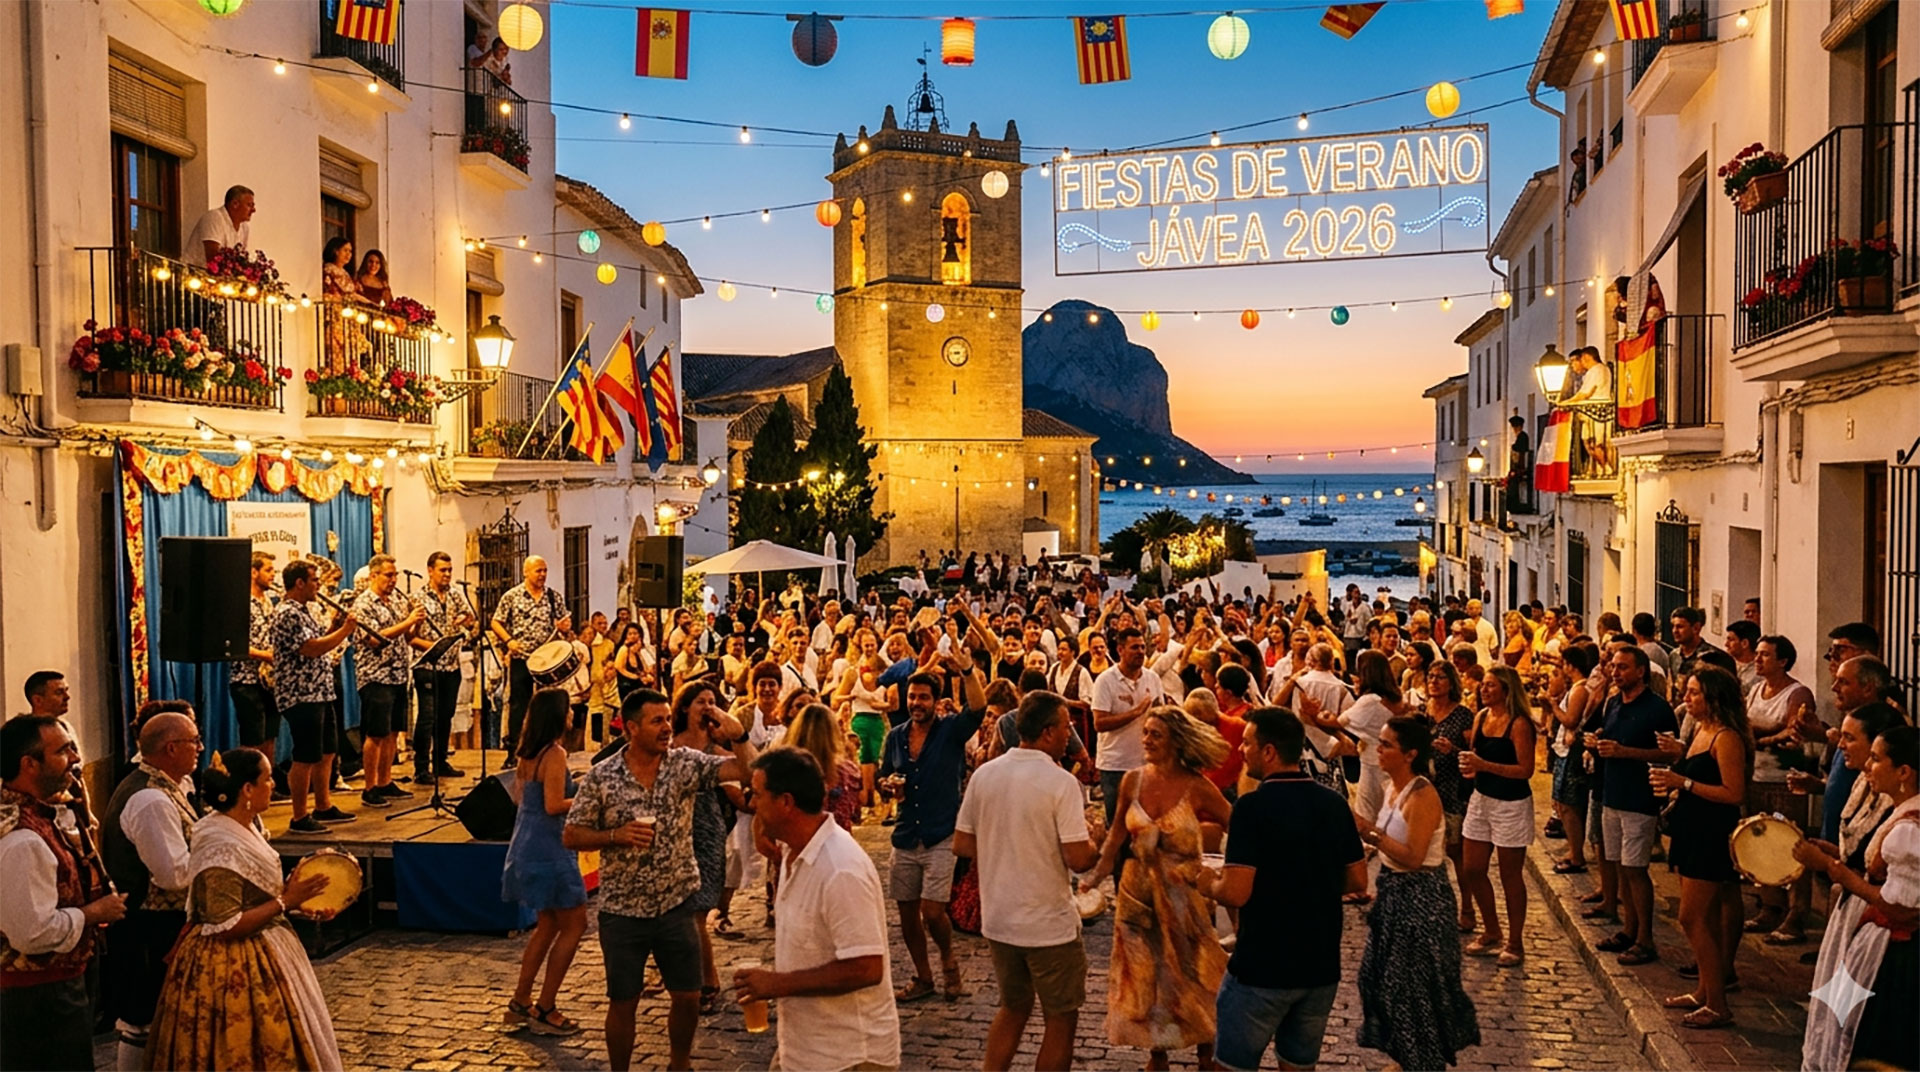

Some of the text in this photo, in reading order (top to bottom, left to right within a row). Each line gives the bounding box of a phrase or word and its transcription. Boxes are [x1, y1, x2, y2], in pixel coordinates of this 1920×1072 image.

[1059, 133, 1483, 210] FIESTAS DE VERANO
[1138, 203, 1397, 267] JÁVEA 2026
